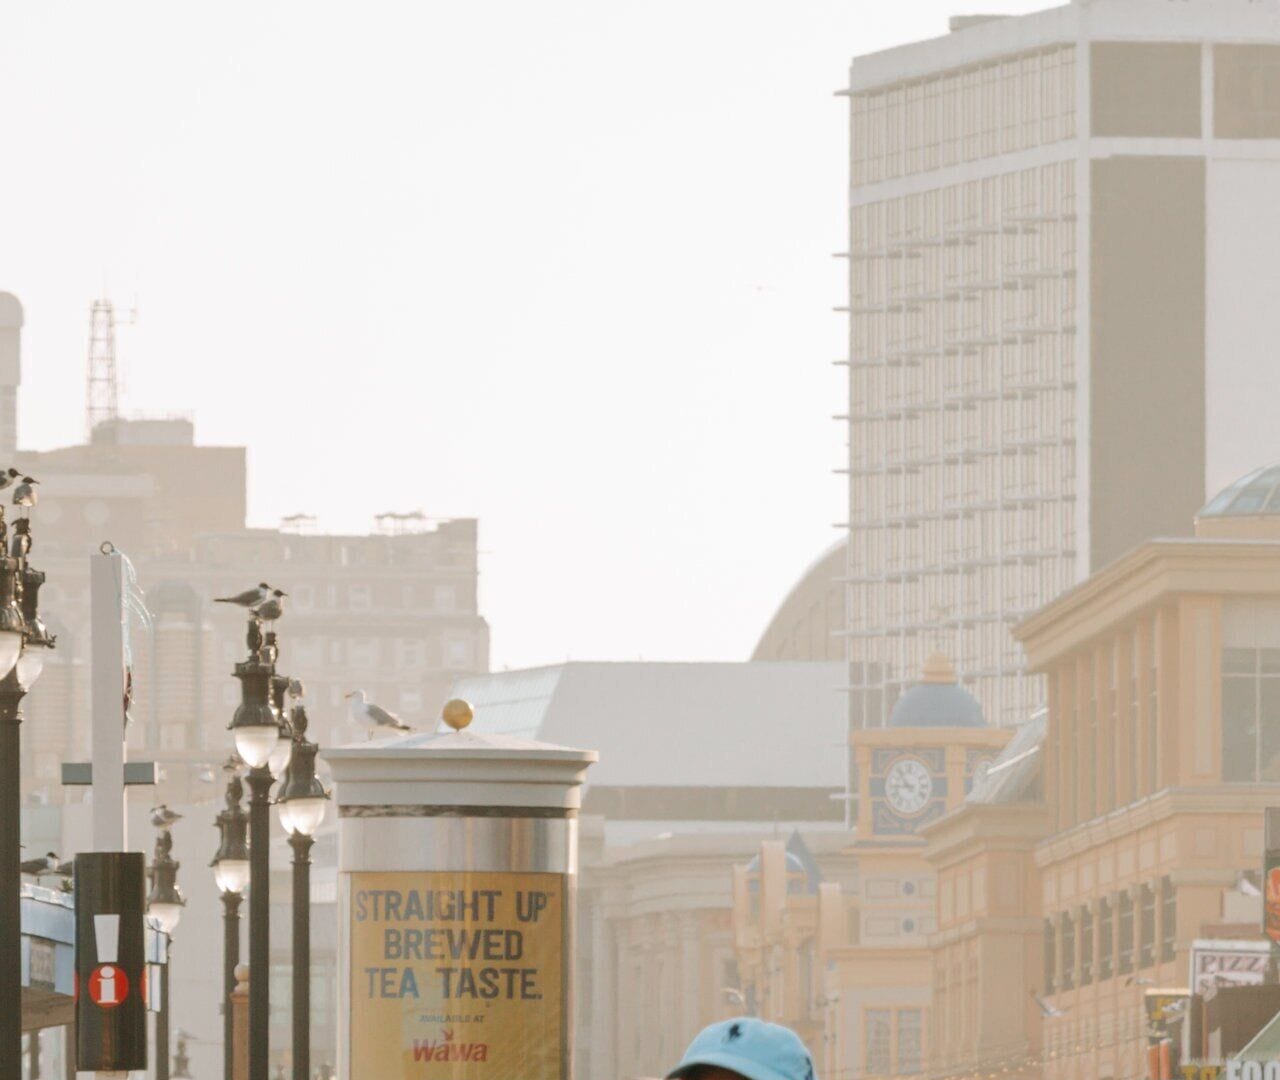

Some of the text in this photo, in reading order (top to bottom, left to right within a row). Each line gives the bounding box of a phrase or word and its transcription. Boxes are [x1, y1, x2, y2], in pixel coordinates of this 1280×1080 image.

[355, 889, 548, 922] STRAIGHT UP
[384, 928, 523, 961] BREWED
[365, 967, 543, 1000] TEA TASTE.
